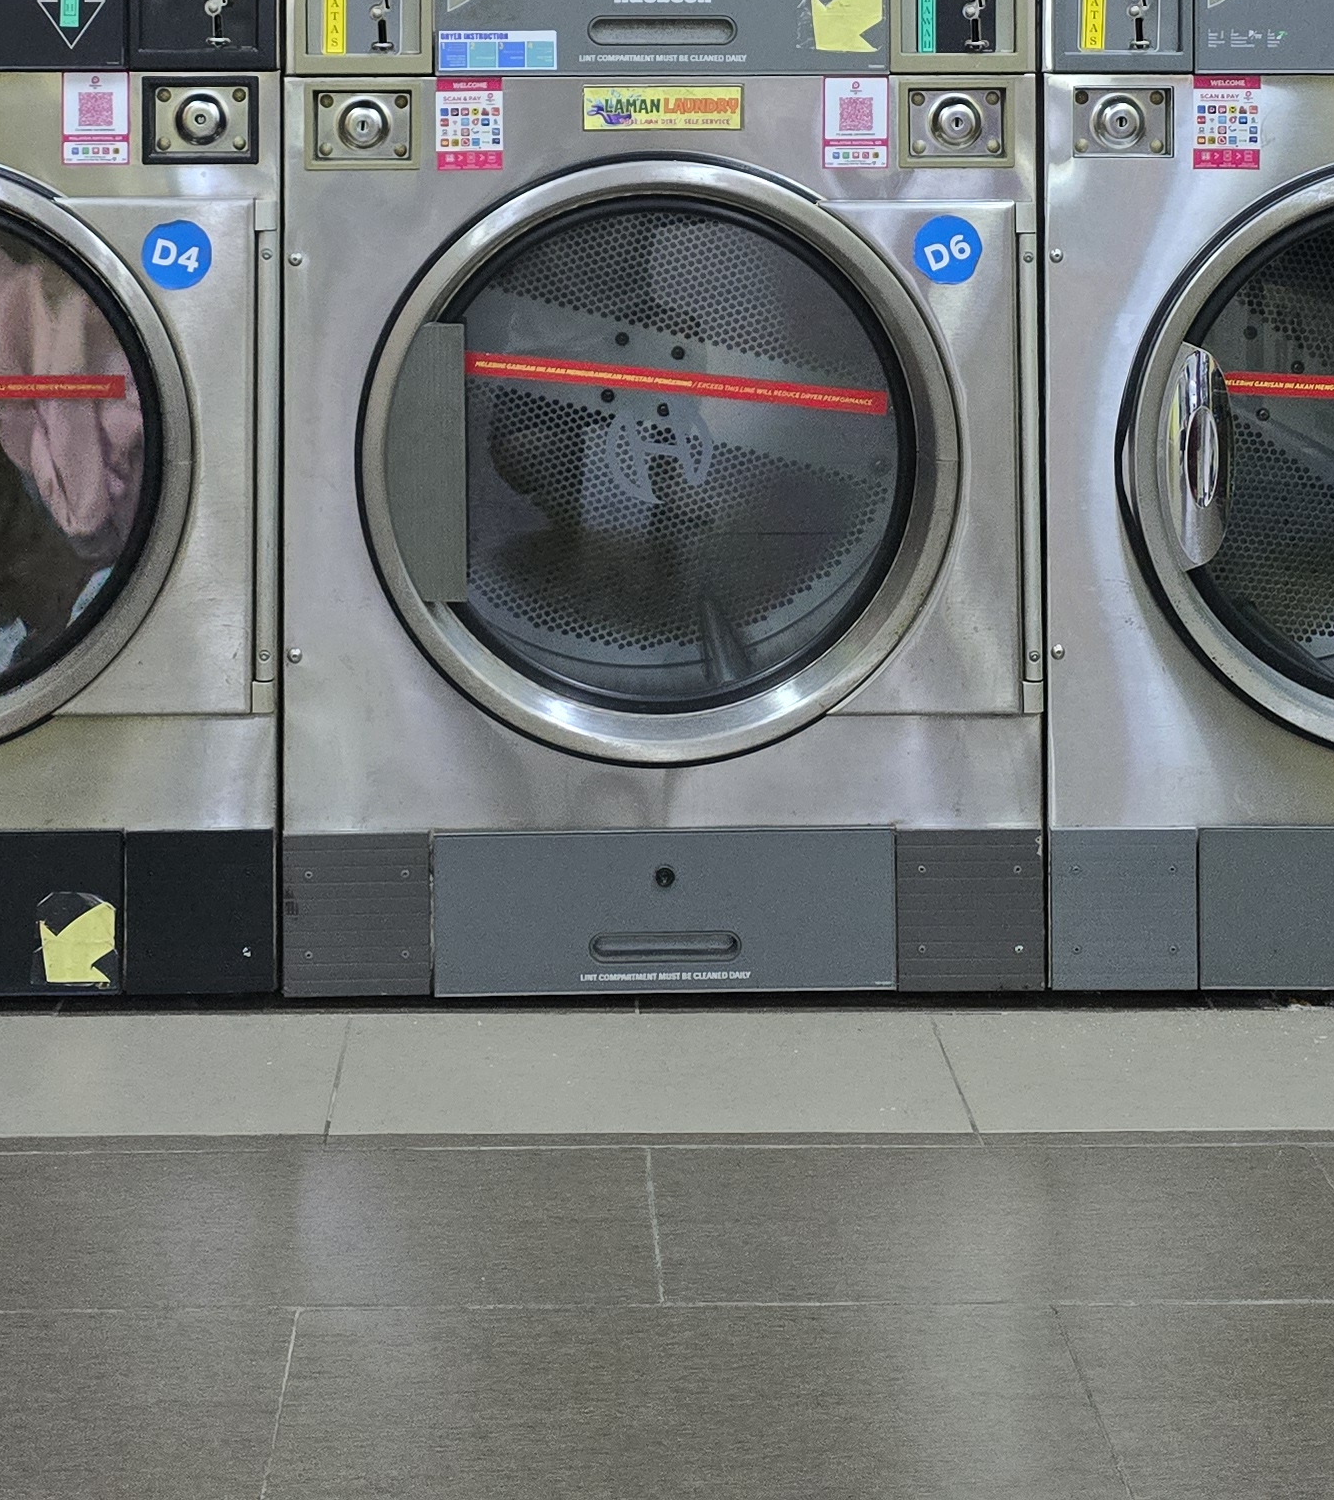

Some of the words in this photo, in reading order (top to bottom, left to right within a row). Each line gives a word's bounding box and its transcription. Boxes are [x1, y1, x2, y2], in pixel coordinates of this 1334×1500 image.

[605, 98, 661, 115] LAMAN
[663, 97, 739, 116] LAUNDRY
[152, 238, 199, 273] D4
[924, 235, 970, 271] D6
